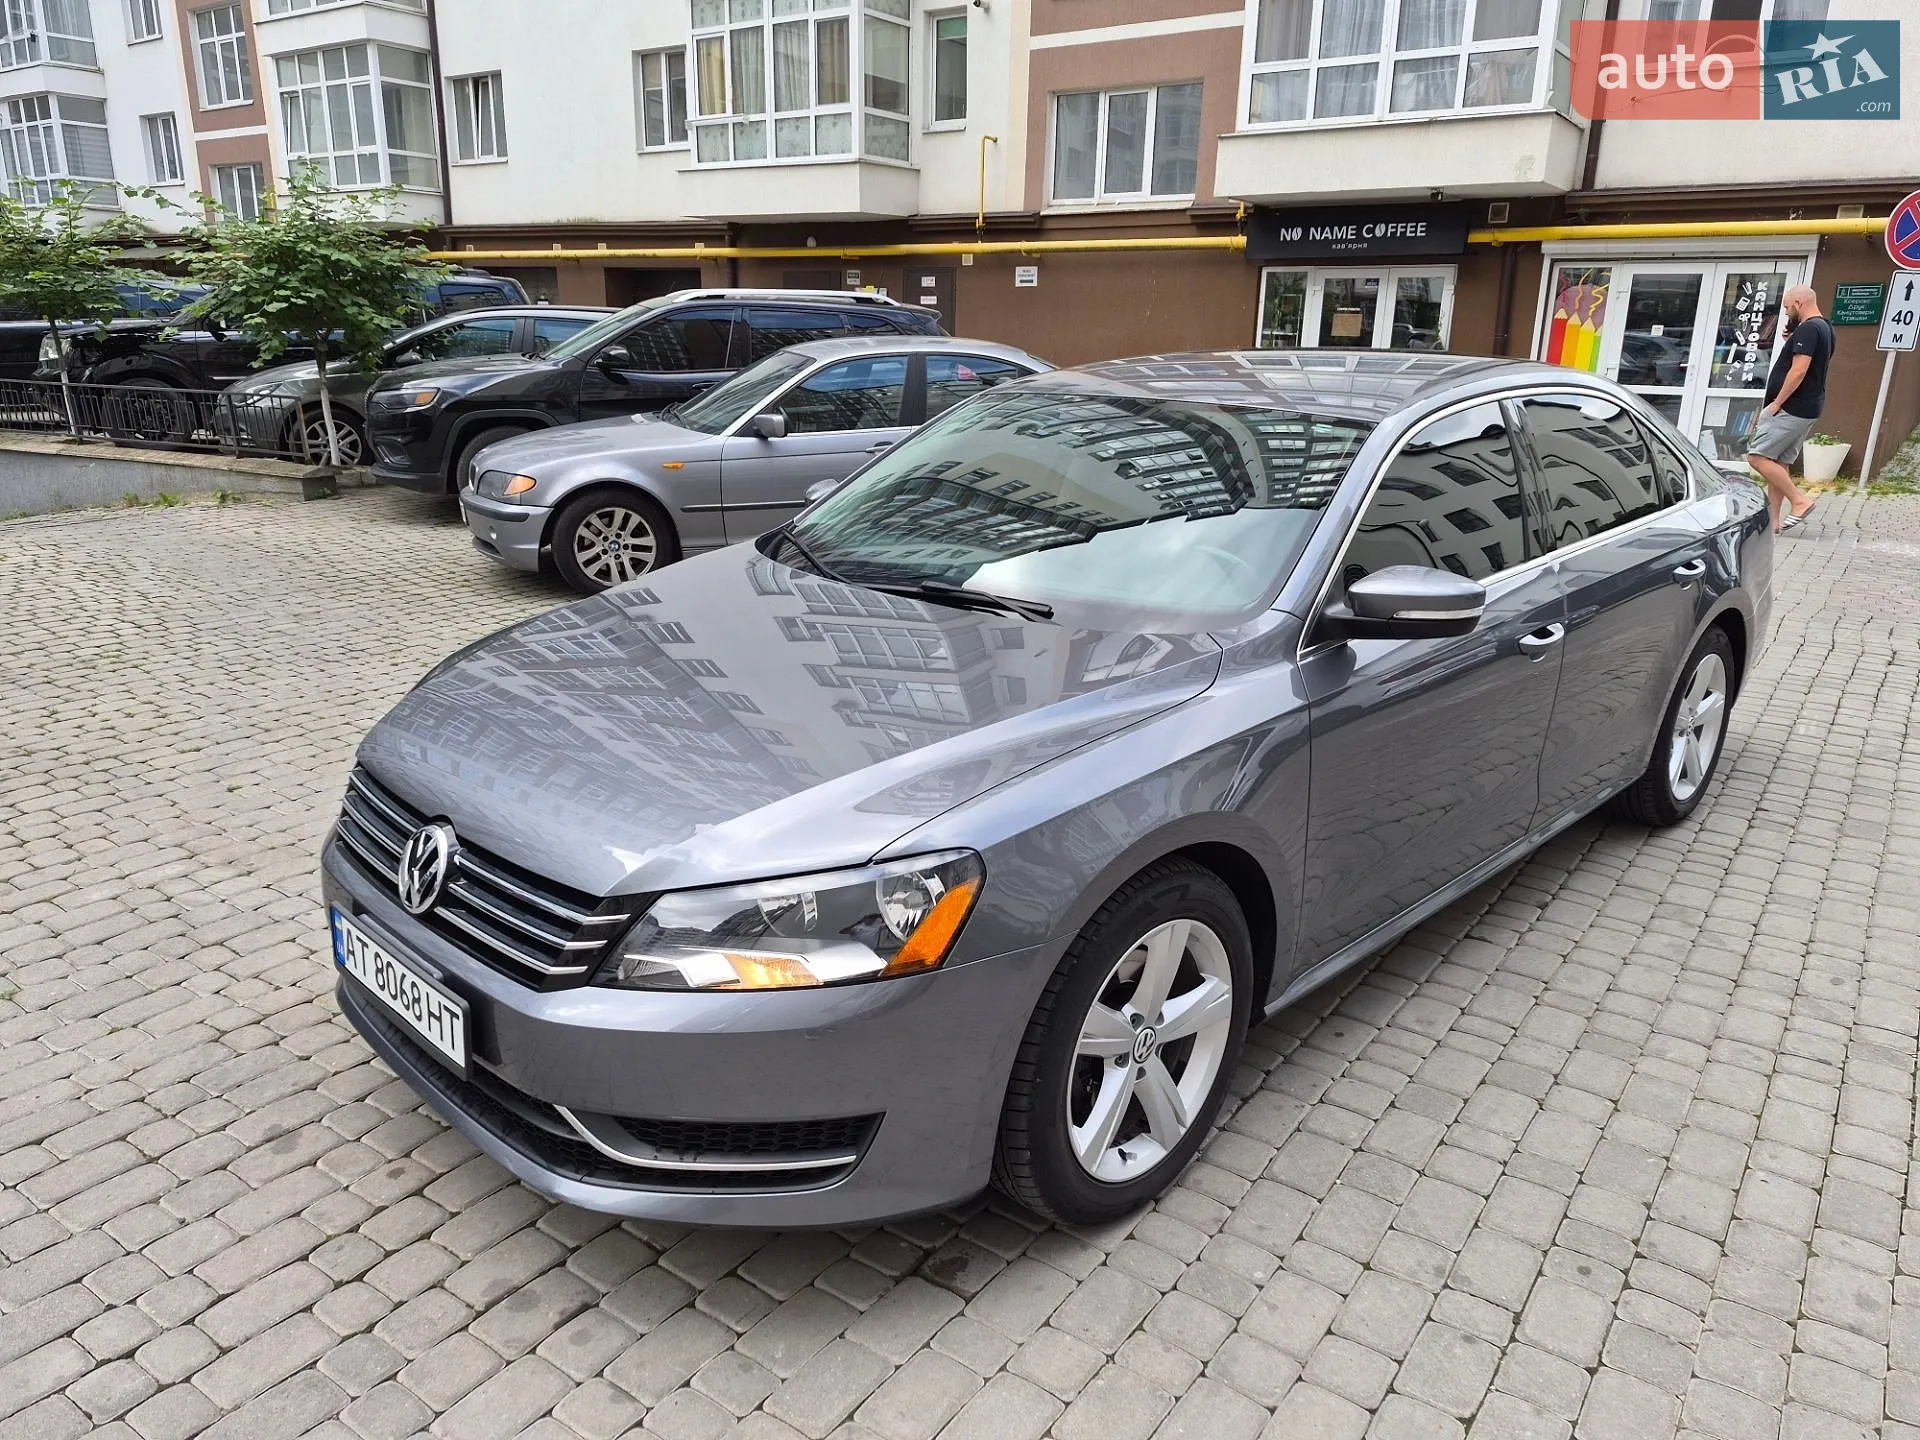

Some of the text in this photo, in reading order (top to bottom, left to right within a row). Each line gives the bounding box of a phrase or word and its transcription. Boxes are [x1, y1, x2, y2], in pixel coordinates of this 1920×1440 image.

[1309, 225, 1358, 241] NAME
[1362, 222, 1428, 238] COFFEE
[1891, 309, 1914, 326] 40
[346, 928, 459, 1052] AT 8068 HT
